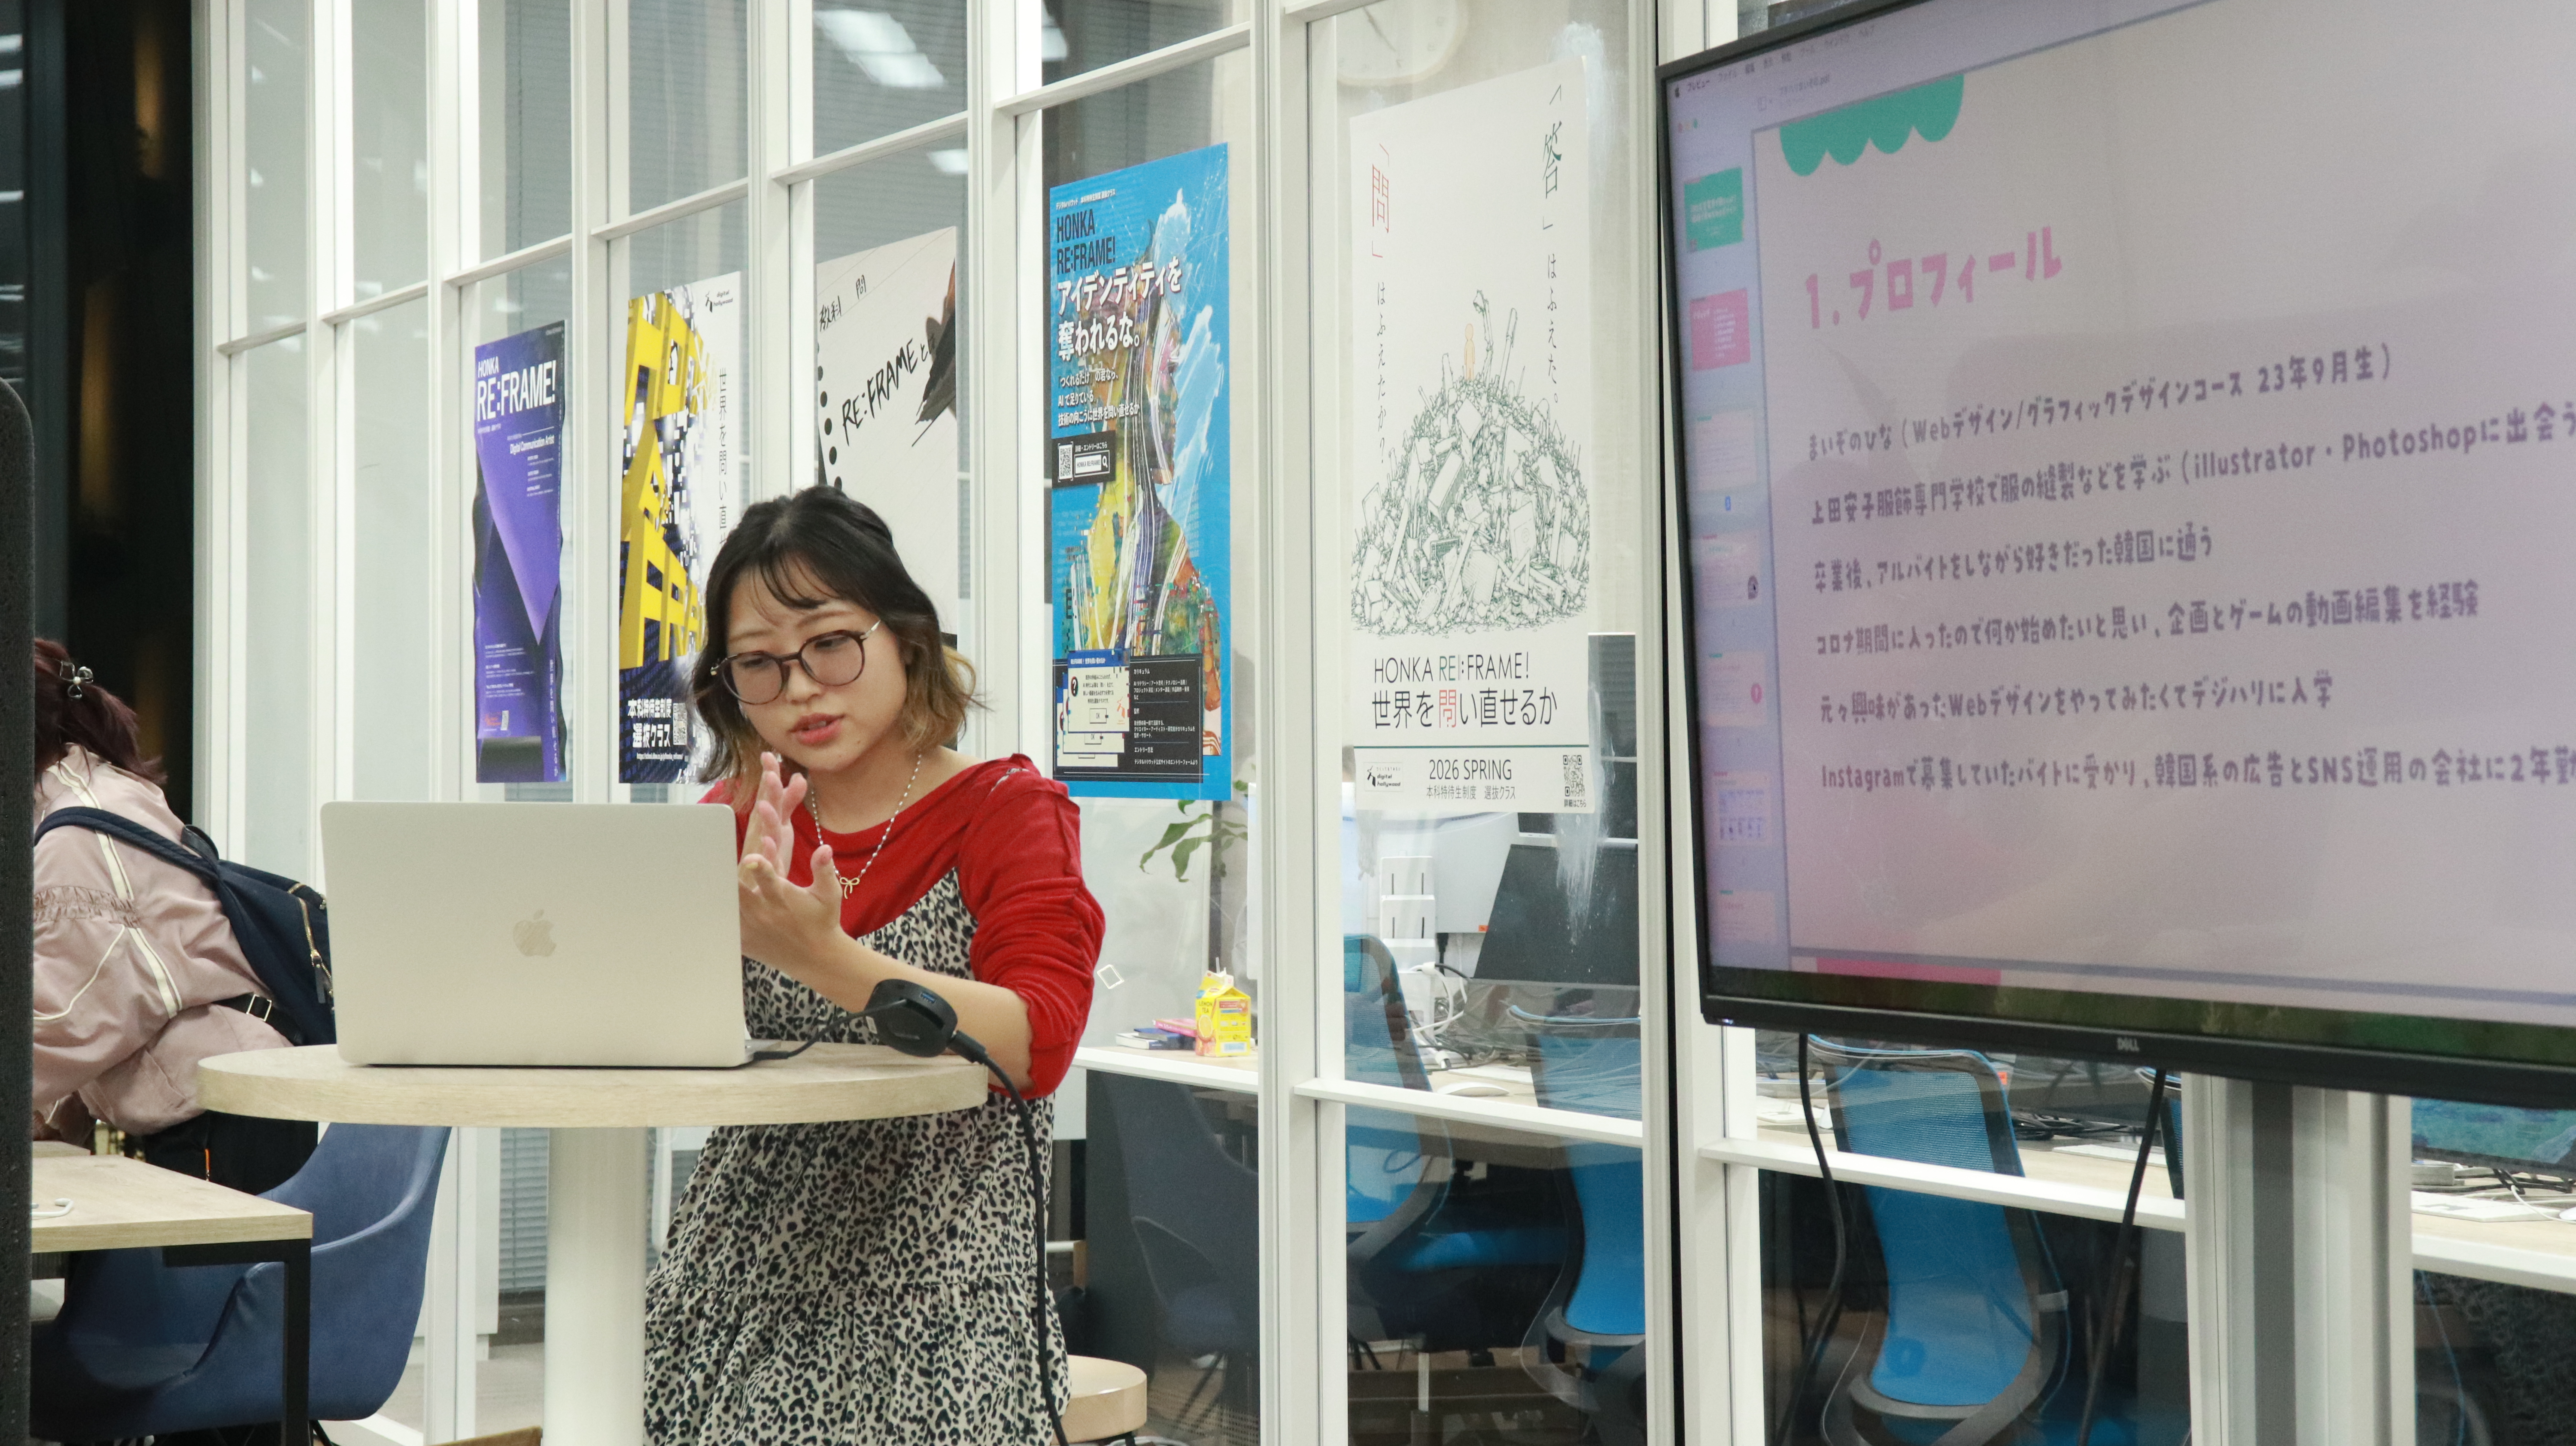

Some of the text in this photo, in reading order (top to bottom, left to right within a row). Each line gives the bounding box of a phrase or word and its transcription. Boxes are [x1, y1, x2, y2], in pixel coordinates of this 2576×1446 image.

[1057, 209, 1095, 243] HONKA
[1057, 236, 1116, 275] RE:FRAME!
[717, 290, 729, 298] digital
[1057, 256, 1182, 316] アイデンティティを
[713, 298, 733, 307] hollywood
[1058, 311, 1140, 362] 奪われるな。
[478, 356, 499, 378] HONKA
[477, 360, 556, 422] RE:FRAME!
[1058, 401, 1140, 427] 技術の向こうに世界を問い直せるか
[1374, 656, 1433, 684] HONKA
[1372, 687, 1557, 729] 世界を問い直せるか
[632, 723, 671, 748] 選抜クラス
[1429, 759, 1512, 781] 2026 SPRING
[1427, 785, 1516, 800] 本科特待生制度 選抜クラス
[2117, 1037, 2140, 1051] DELL
